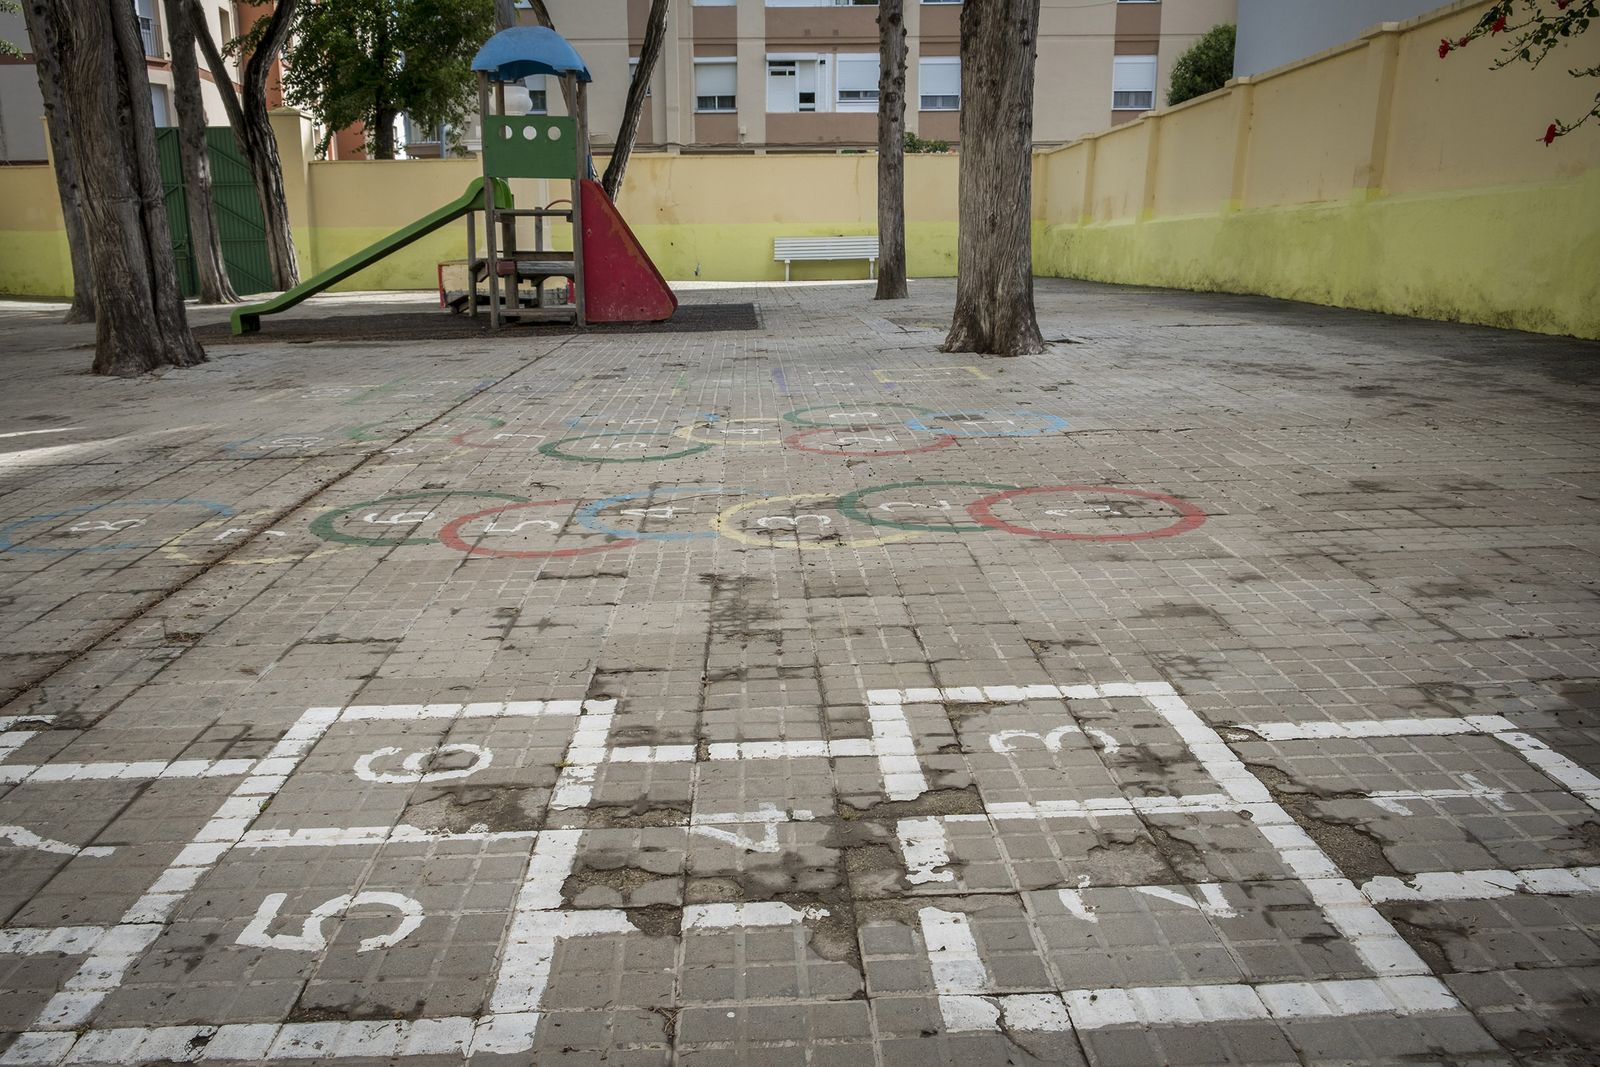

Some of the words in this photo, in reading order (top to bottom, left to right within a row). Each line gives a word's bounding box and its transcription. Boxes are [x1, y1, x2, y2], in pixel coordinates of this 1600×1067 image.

[619, 506, 690, 518] 4
[879, 500, 952, 512] 2
[1044, 506, 1121, 517] 1
[364, 511, 435, 524] 6
[757, 514, 832, 528] 3
[70, 519, 147, 531] 8
[483, 520, 560, 532] 5
[988, 725, 1121, 755] 3
[353, 743, 494, 783] 6
[688, 802, 815, 853] 4
[235, 891, 425, 953] 5
